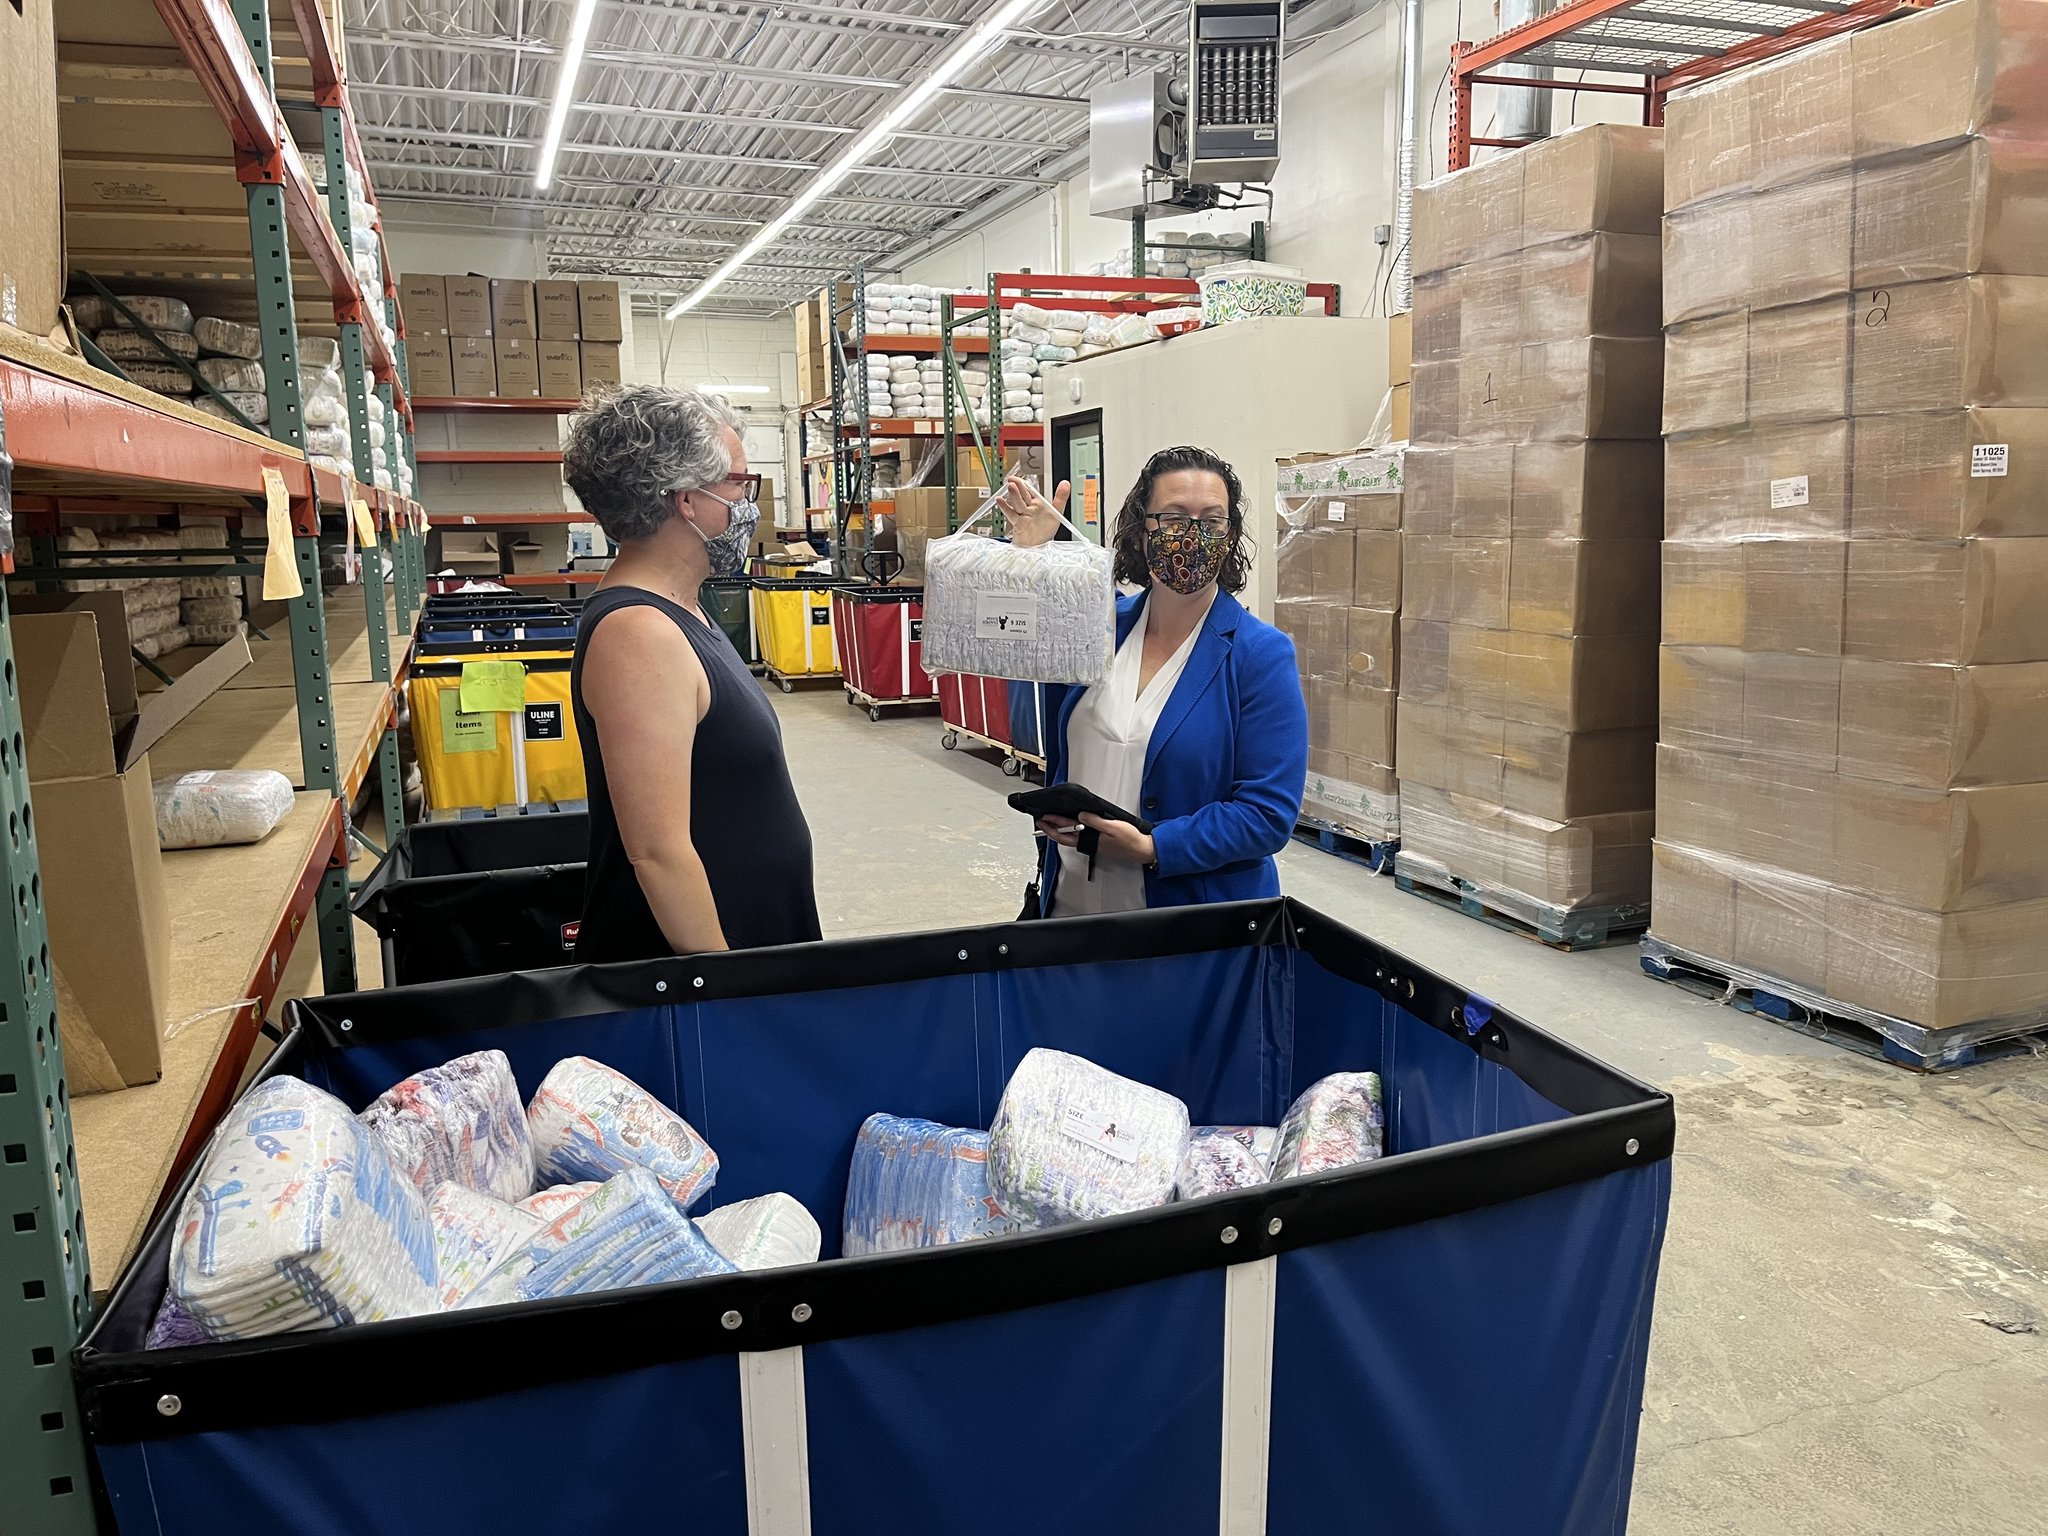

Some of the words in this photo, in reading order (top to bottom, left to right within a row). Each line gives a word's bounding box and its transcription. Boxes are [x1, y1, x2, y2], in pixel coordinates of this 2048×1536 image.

[1866, 290, 1890, 327] 2
[1482, 372, 1498, 404] 1
[1974, 447, 2005, 456] 11025
[530, 711, 555, 719] ULINE
[455, 721, 482, 729] Items
[566, 928, 579, 936] Ru
[1068, 1108, 1085, 1120] SIZE
